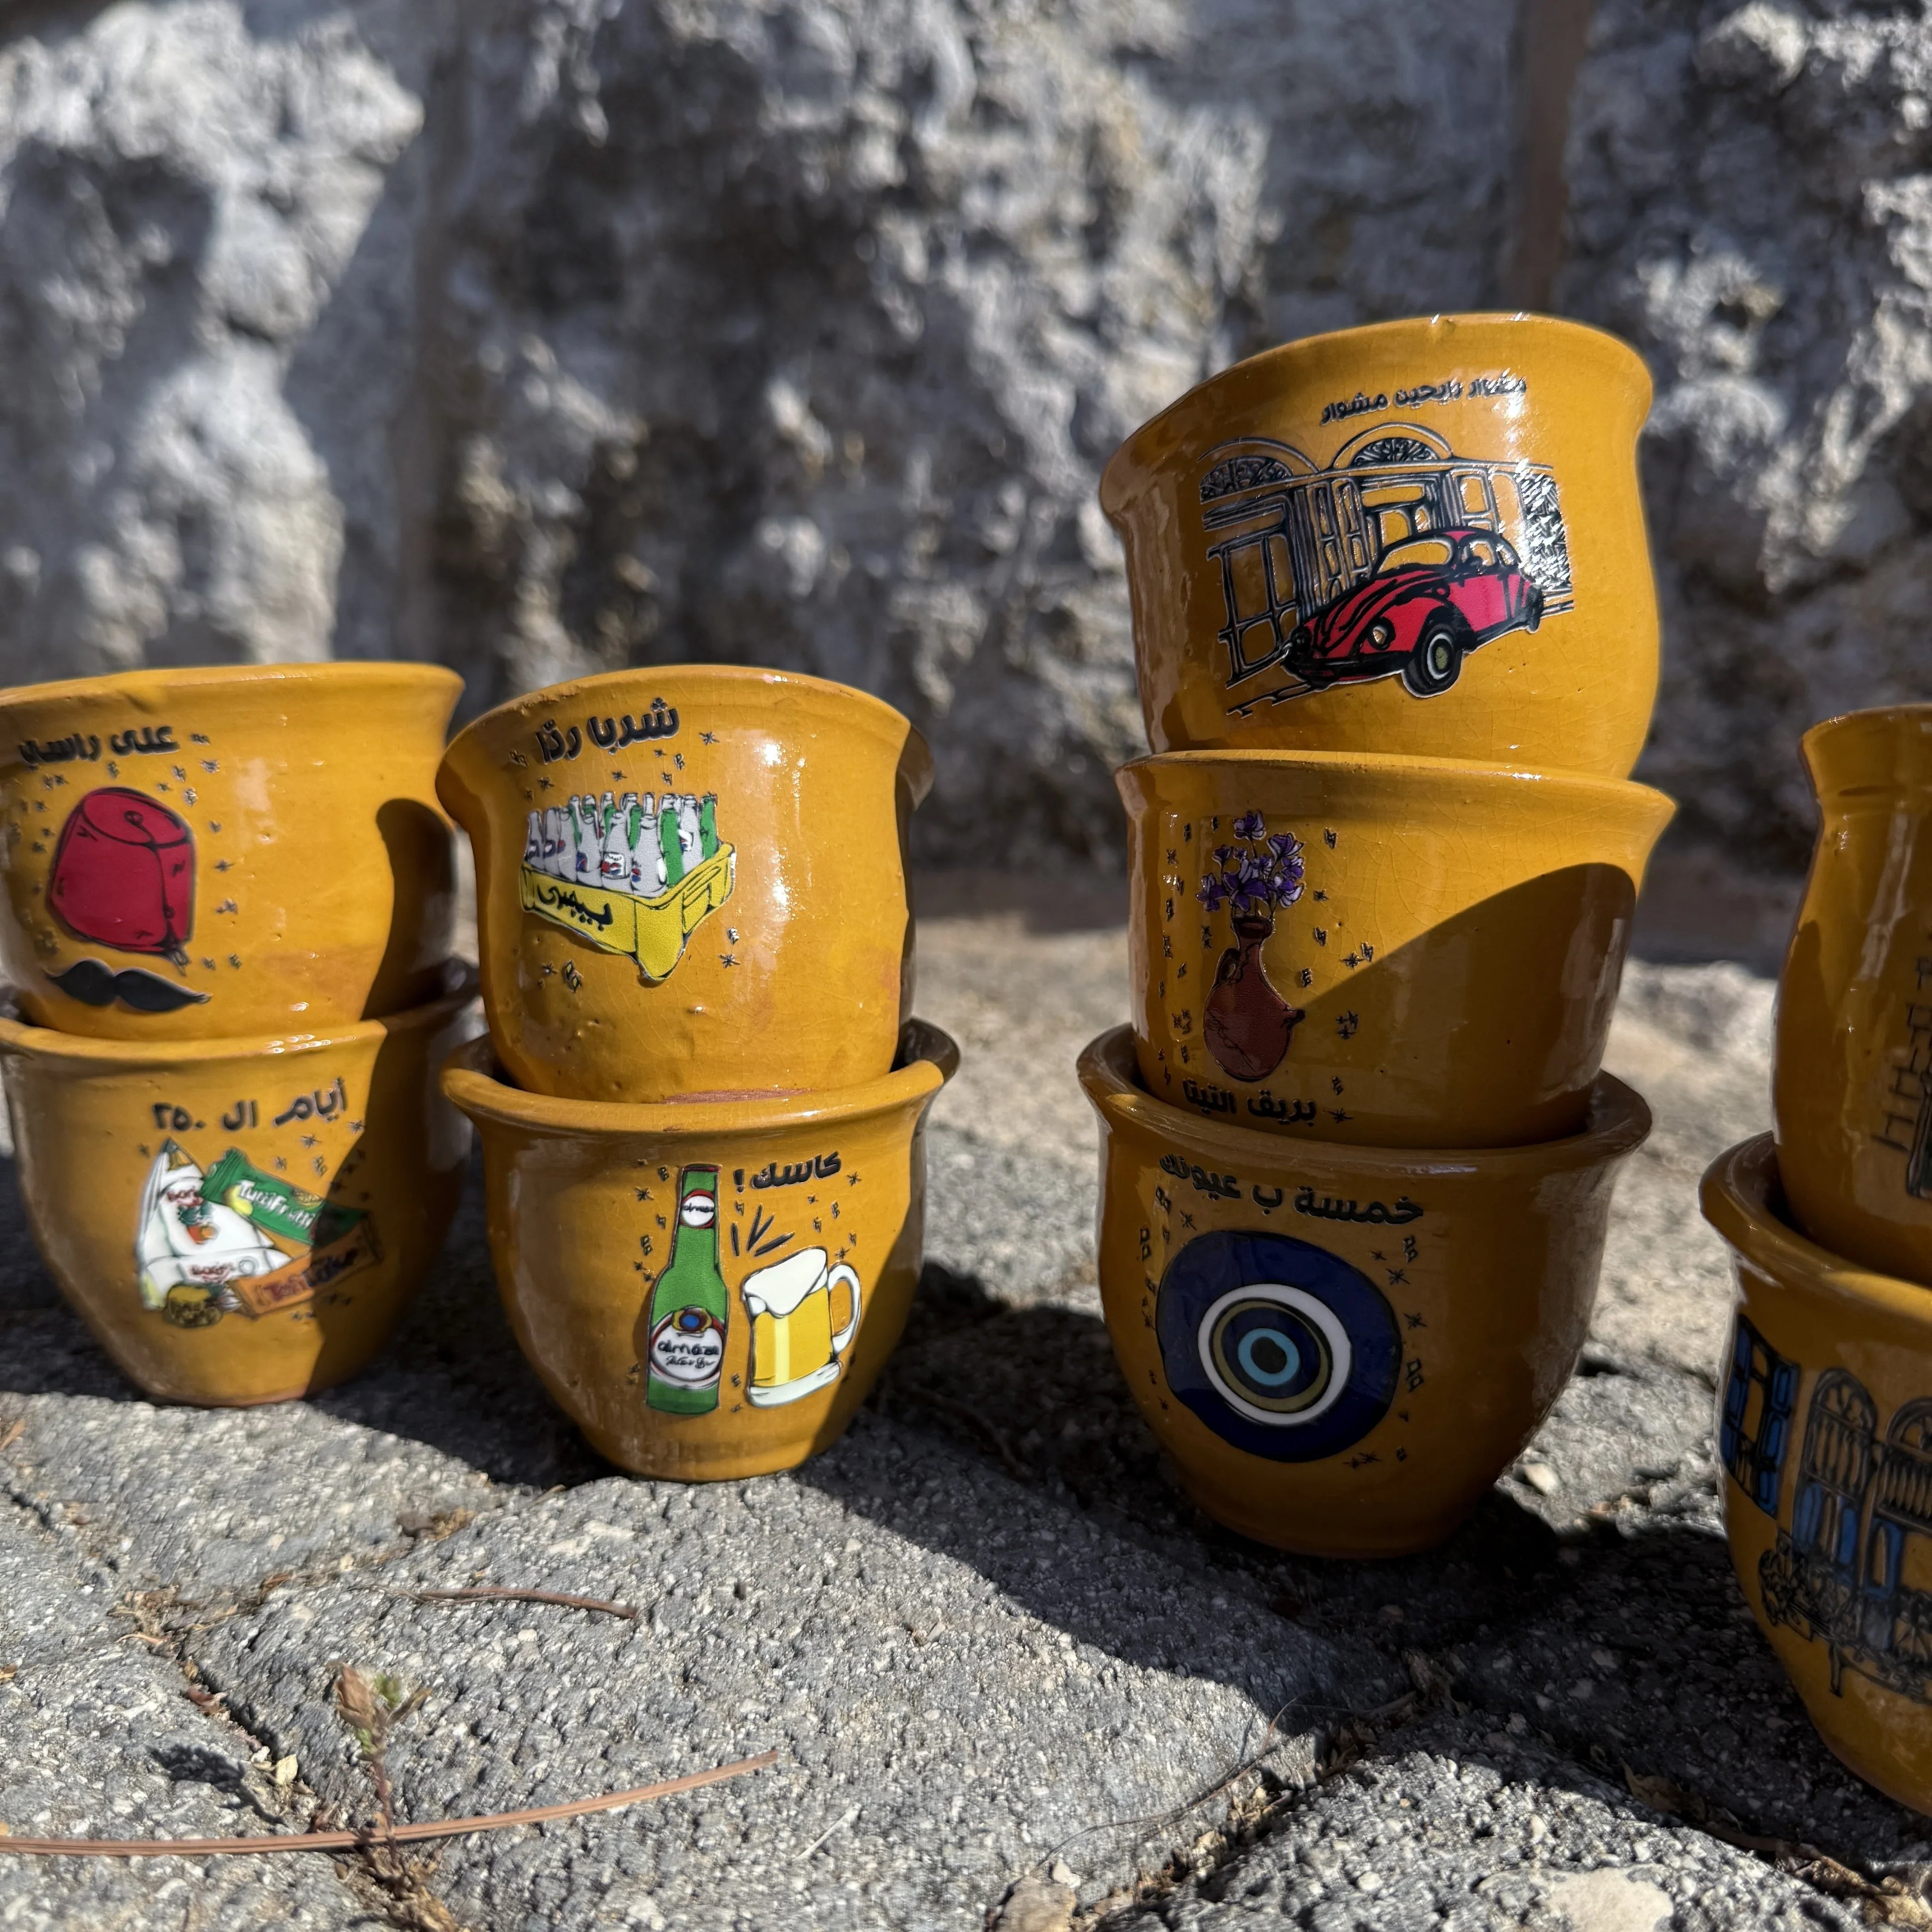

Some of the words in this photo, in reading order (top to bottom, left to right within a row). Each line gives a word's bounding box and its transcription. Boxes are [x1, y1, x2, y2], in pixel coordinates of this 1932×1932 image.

[1319, 392, 1390, 426] مشوار
[110, 726, 181, 756] على
[587, 697, 681, 755] شربا
[222, 1099, 259, 1131] ال
[273, 1076, 348, 1127] أيام
[1246, 1089, 1317, 1127] بريق
[1251, 1184, 1283, 1216] ب
[1294, 1185, 1424, 1225] خمسة
